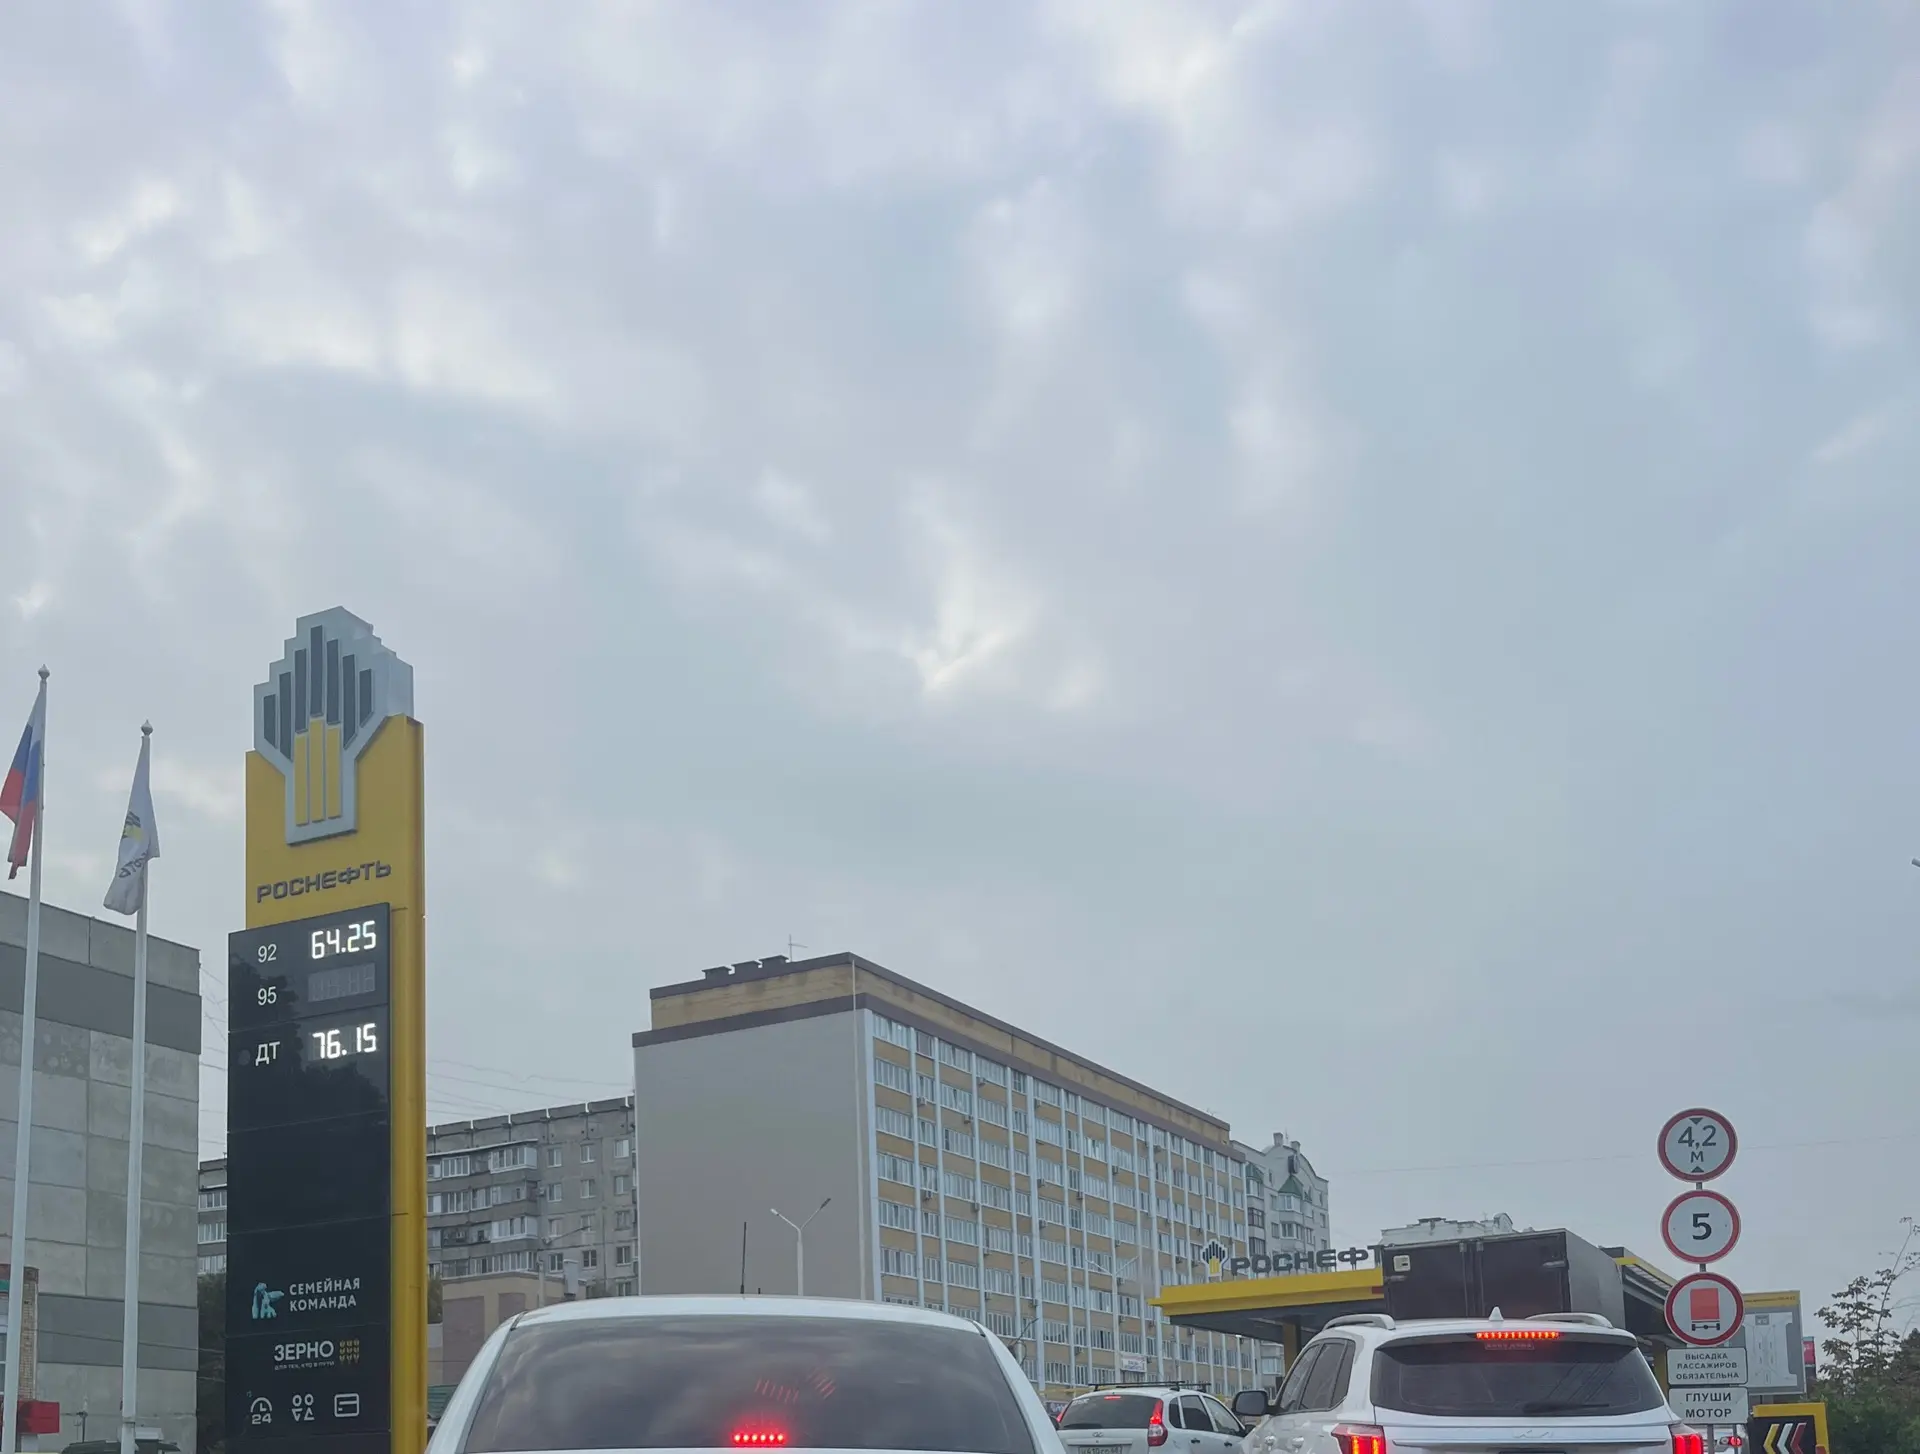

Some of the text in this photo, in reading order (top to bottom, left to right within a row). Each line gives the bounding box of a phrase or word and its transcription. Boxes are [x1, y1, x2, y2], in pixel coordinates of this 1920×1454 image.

[257, 860, 391, 903] РОСНЕФТЬ
[258, 920, 376, 963] 92 64.25
[258, 986, 277, 1005] 95
[255, 1023, 376, 1066] ДТ 76.15
[1677, 1125, 1717, 1150] 4,2
[1692, 1213, 1712, 1240] 5
[1231, 1244, 1384, 1276] РОСНЕФТ
[289, 1277, 360, 1296] СЕМЕЙНАЯ
[290, 1295, 357, 1312] КОМАНДА
[274, 1340, 334, 1361] ЗЕРНО
[1685, 1353, 1728, 1361] ВЫСАДКА
[1676, 1372, 1739, 1380] ОБЯЗАТЕЛЬНА
[1685, 1392, 1731, 1402] ГЛУШИ
[251, 1413, 272, 1425] 24
[1685, 1409, 1731, 1418] МОТОР
